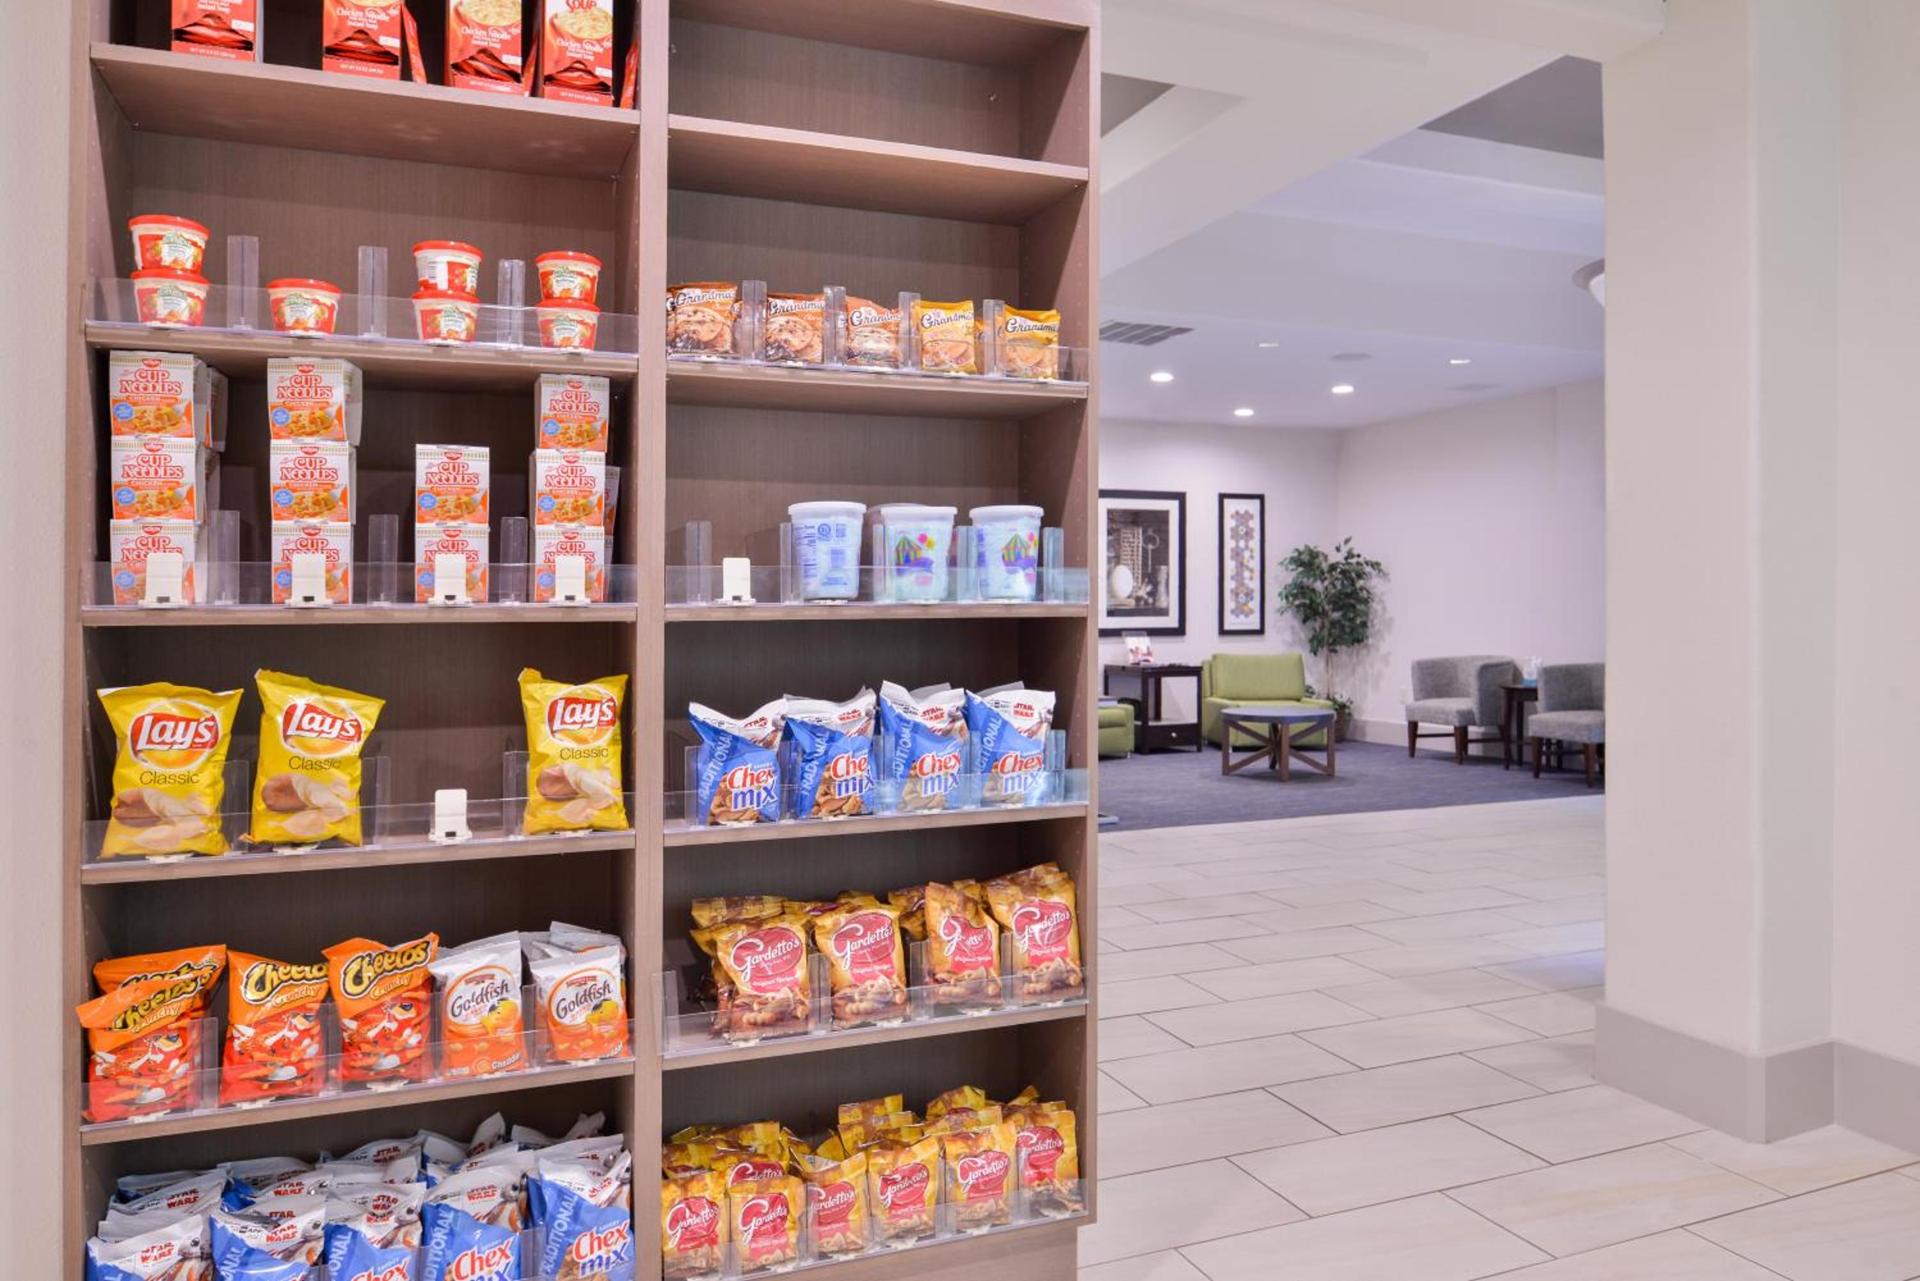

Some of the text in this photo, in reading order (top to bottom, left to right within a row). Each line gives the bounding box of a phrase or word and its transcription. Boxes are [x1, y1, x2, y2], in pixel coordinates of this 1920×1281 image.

[135, 368, 170, 382] CUP
[290, 375, 322, 387] CUP
[120, 380, 182, 394] NOODLES
[277, 386, 333, 400] NOODLES
[561, 389, 590, 401] CUP
[549, 399, 599, 414] NOODLES
[137, 454, 172, 467] CUP
[294, 457, 327, 470] CUP
[437, 461, 469, 474] CUP
[122, 464, 184, 479] NOODLES
[280, 467, 338, 482] NOODLES
[558, 465, 586, 477] CUP
[425, 472, 479, 485] NOODLES
[545, 475, 596, 488] NOODLES
[135, 536, 171, 550] CUP
[296, 538, 329, 551] CUP
[437, 540, 469, 552] CUP
[557, 541, 585, 553] CUP
[286, 702, 358, 739] Lay's
[552, 699, 614, 732] Lay's
[136, 714, 216, 750] Lay's
[559, 748, 609, 761] Classic
[288, 755, 342, 770] Classic
[831, 752, 868, 780] Che
[999, 751, 1044, 775] Chex
[140, 771, 200, 785] Classic
[727, 763, 775, 791] Chex
[732, 777, 778, 811] mix
[730, 937, 800, 982] Gardetto's
[343, 941, 430, 997] Cheetos
[451, 979, 510, 1018] Goldfish
[556, 980, 612, 1020] Goldfish
[166, 1196, 199, 1209] WARS
[573, 1221, 629, 1261] Chex
[453, 1238, 512, 1281] Chex
[580, 1241, 629, 1278] mix
